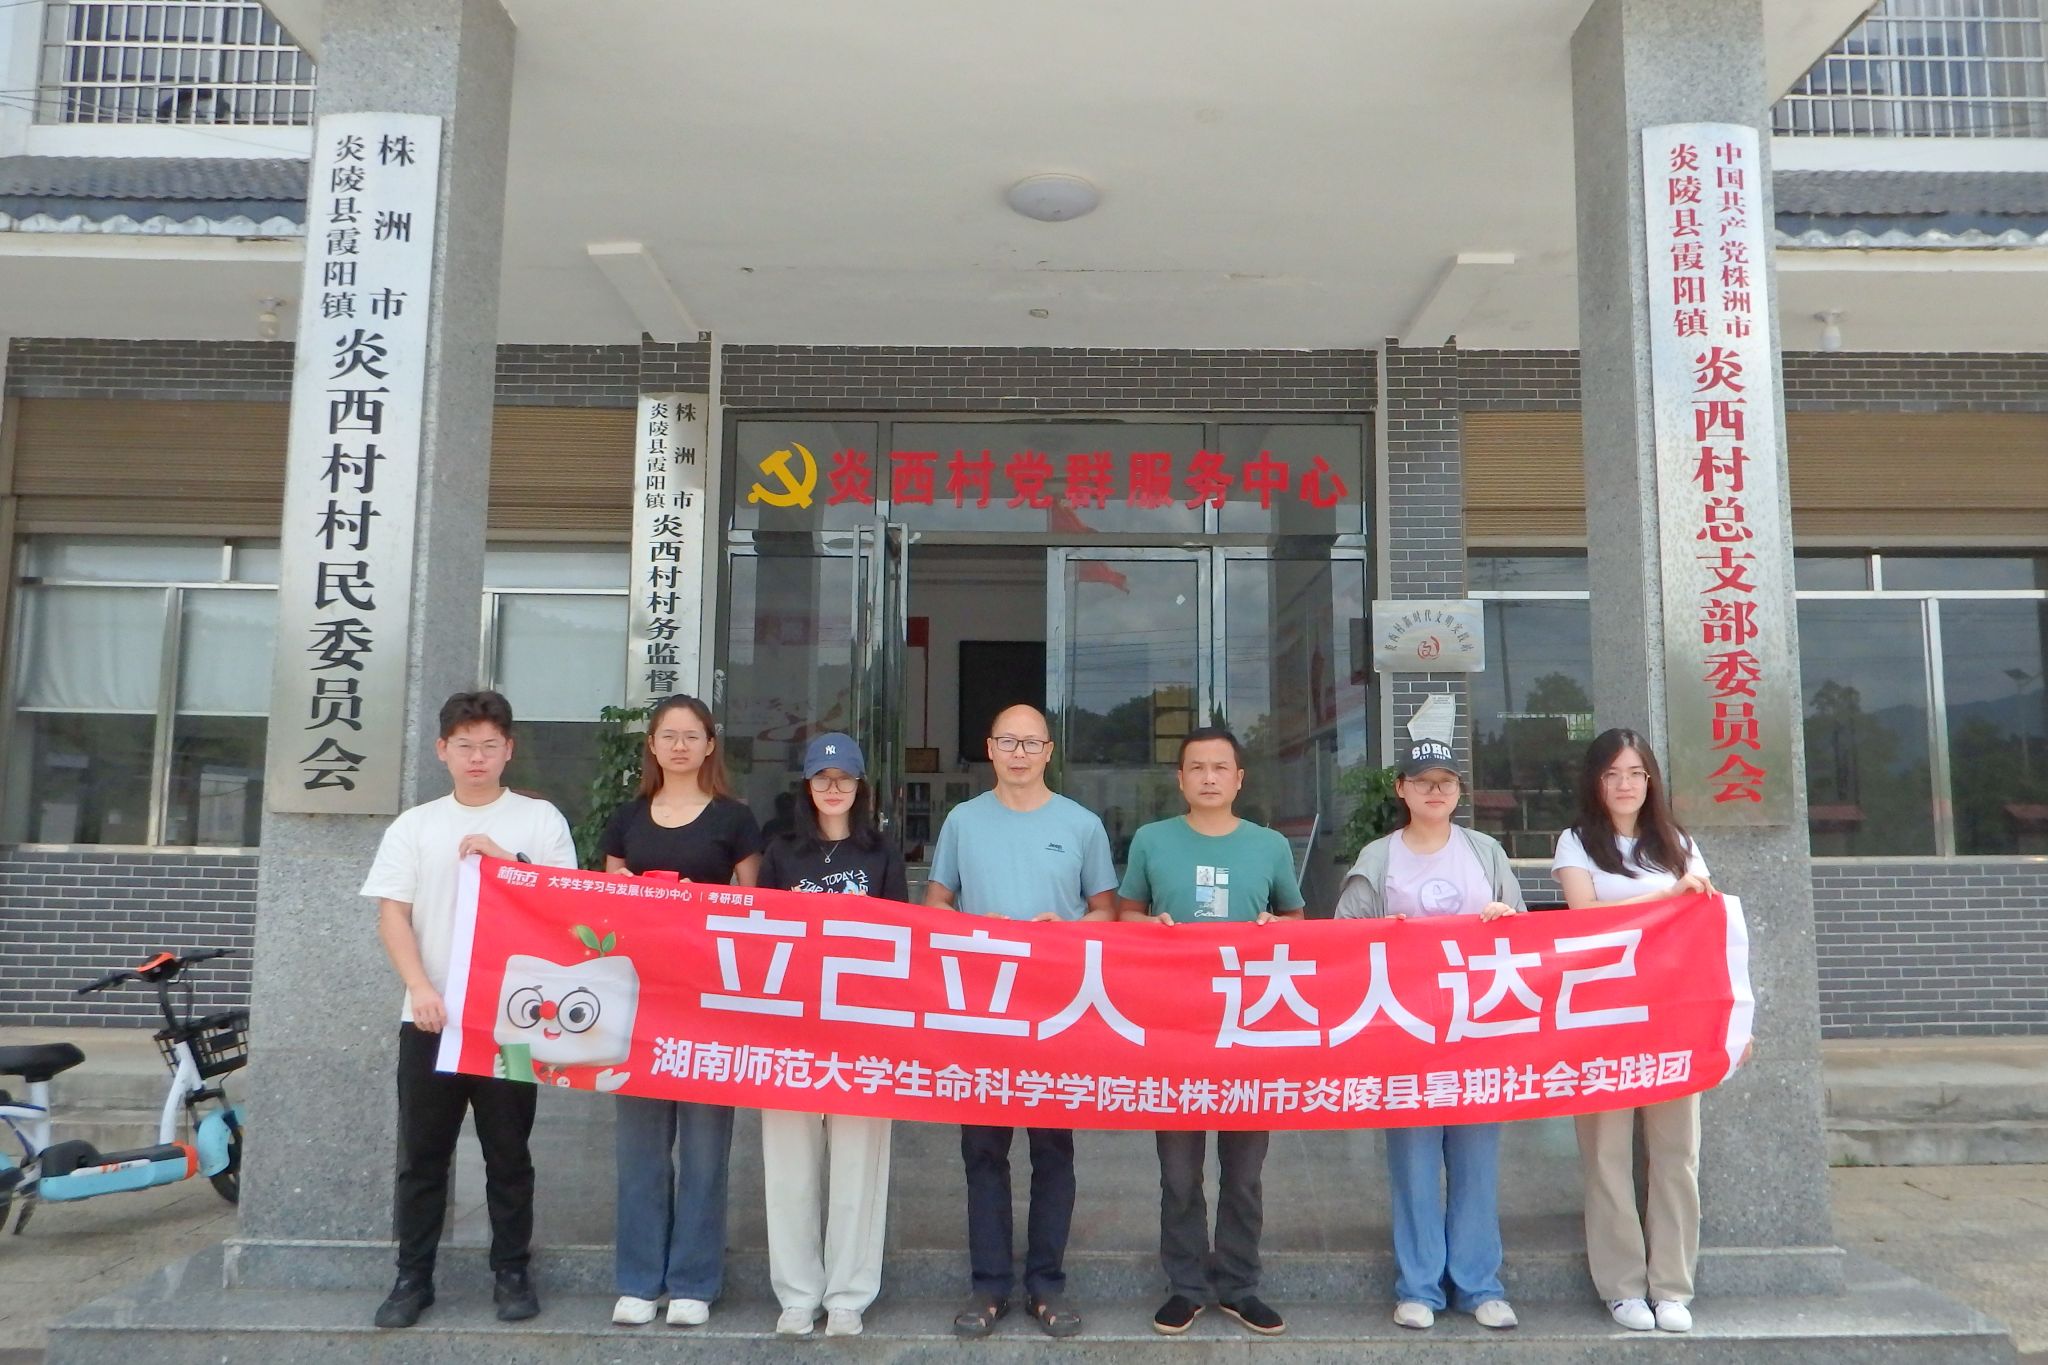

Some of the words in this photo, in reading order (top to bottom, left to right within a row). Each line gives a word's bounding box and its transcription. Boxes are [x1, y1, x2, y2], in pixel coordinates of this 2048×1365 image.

[321, 135, 365, 320] 炎陵县霞阳镇
[370, 134, 415, 320] 株洲市
[1668, 143, 1708, 338] 炎陵县霞阳镇
[1716, 143, 1752, 338] 中国共产党株洲市
[646, 403, 668, 508] 炎陵县霞阳镇
[672, 402, 697, 510] 株洲市
[827, 448, 1349, 510] 炎西村党群服务中心
[299, 328, 390, 792] 炎西村村民委员会
[1692, 345, 1767, 804] 炎西村总支部委员会
[1411, 742, 1452, 760] SOHO
[497, 865, 539, 884] 新东方
[548, 875, 693, 902] 大学生学习与发展(长沙)中心
[707, 891, 754, 907] 考研项目
[821, 870, 854, 886] TODAY
[700, 910, 1146, 1047] 立己立人
[1212, 929, 1649, 1048] 达人达己
[650, 1037, 1693, 1115] 湖南师范大学生命科学学院赴株洲市炎陵县暑期社会实践团
